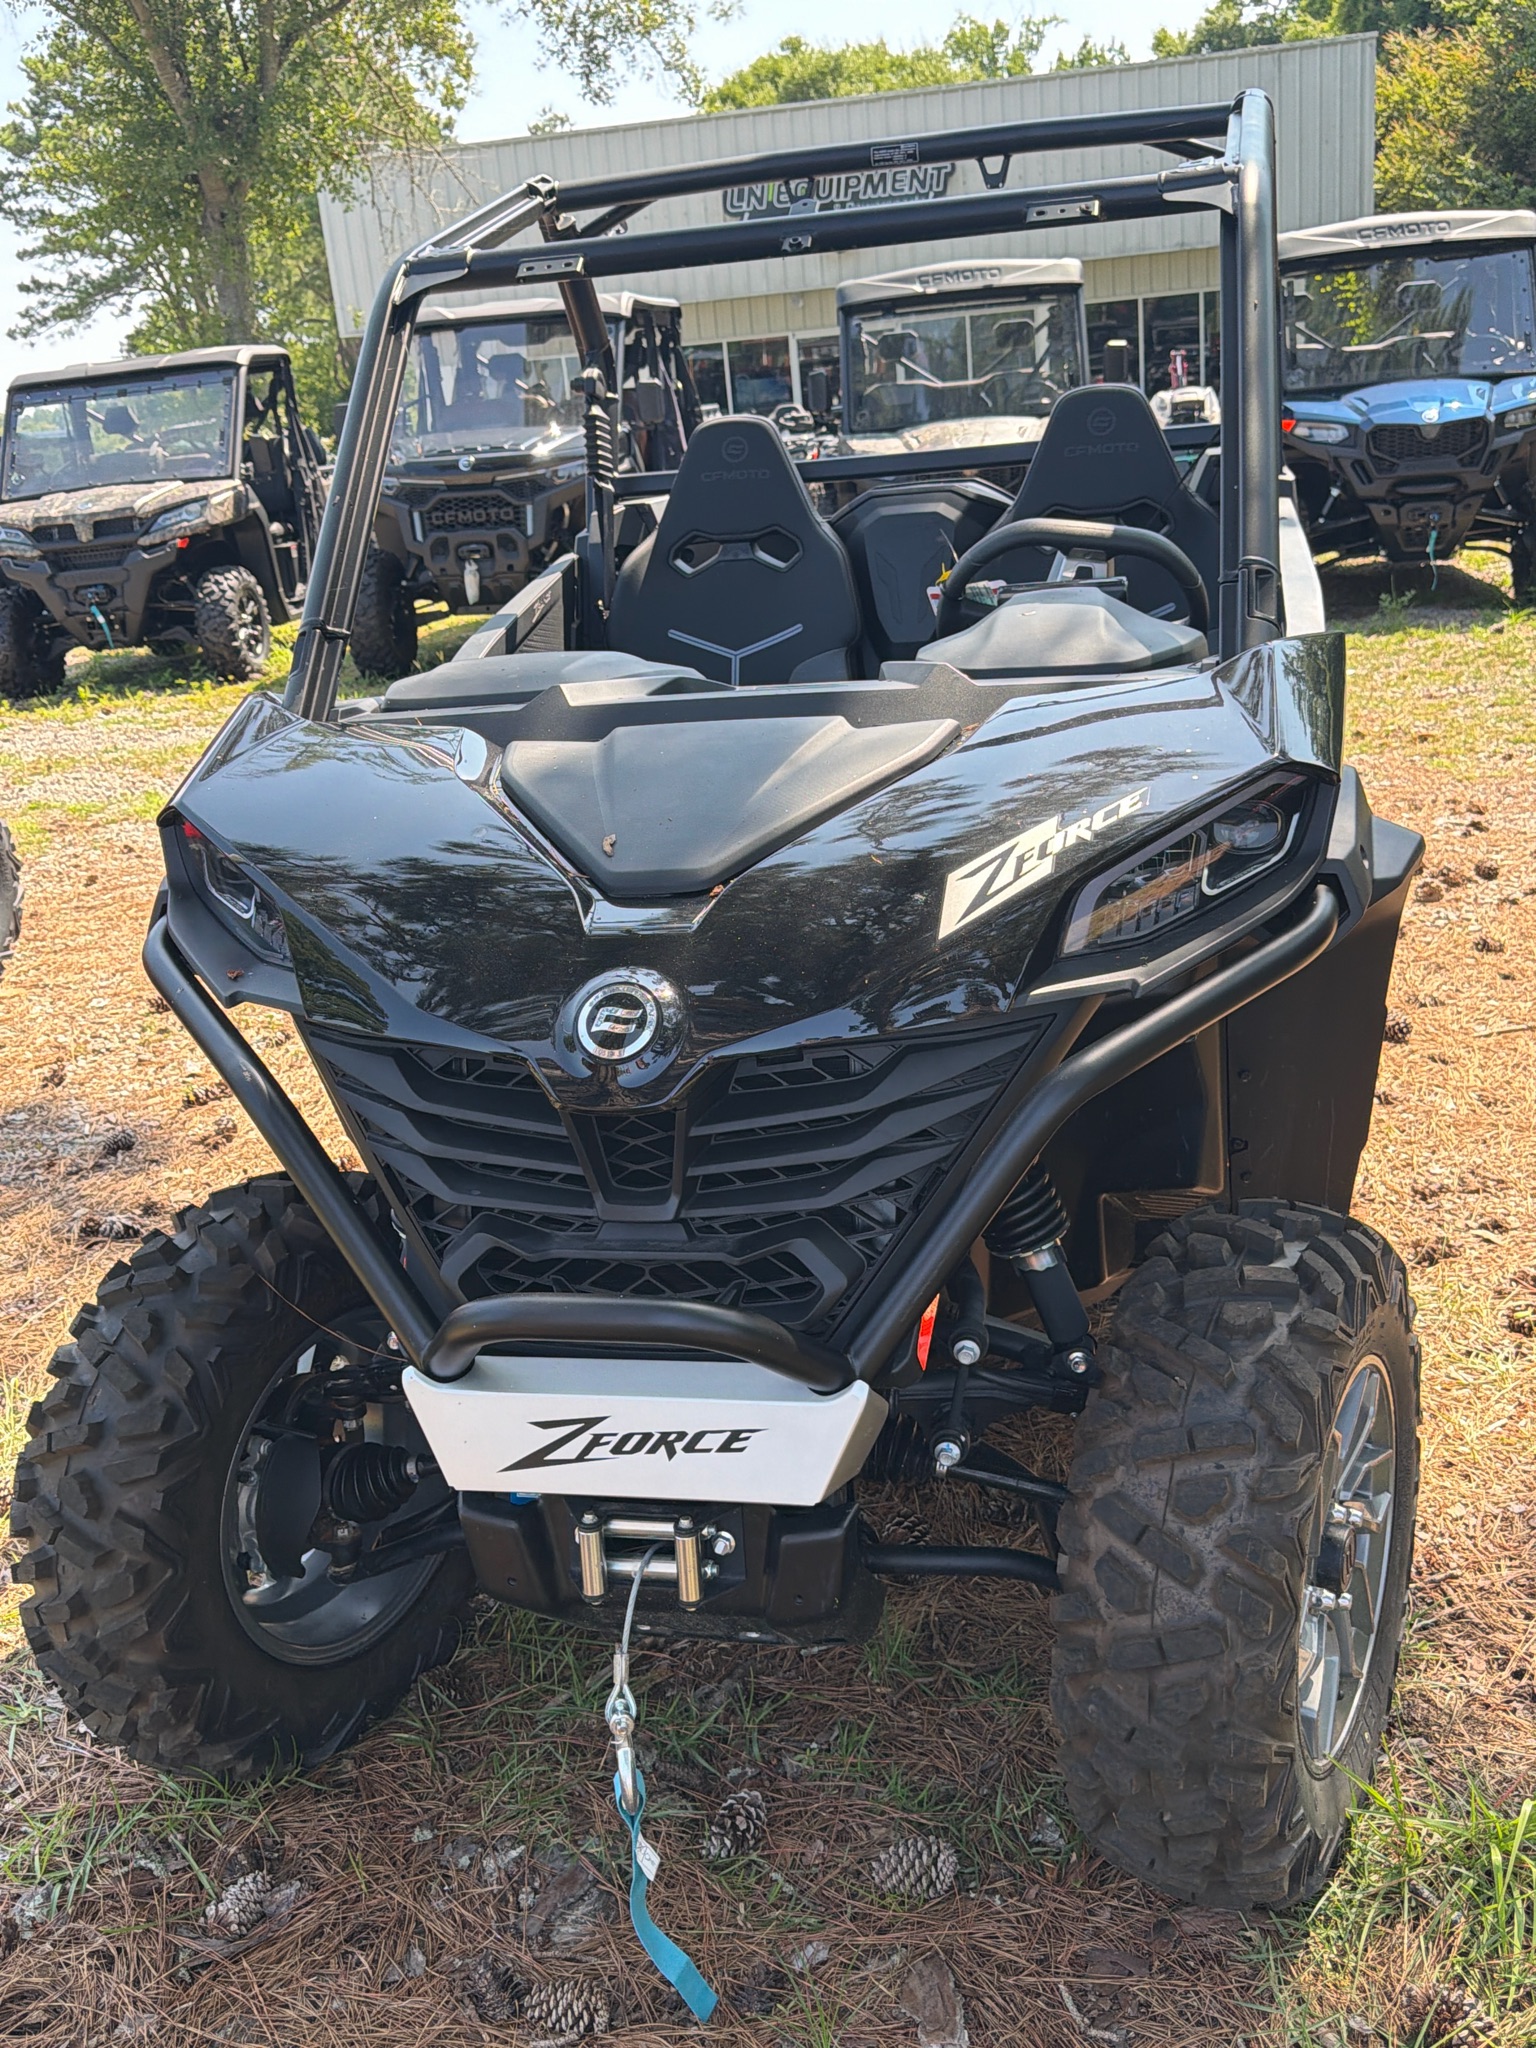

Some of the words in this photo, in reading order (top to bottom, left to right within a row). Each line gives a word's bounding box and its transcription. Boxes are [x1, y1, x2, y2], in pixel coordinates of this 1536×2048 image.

[1356, 220, 1452, 241] CFMOTO
[916, 266, 1002, 287] CFMOTO
[1064, 441, 1140, 457] CFMOTO
[700, 468, 770, 482] CFMOTO
[431, 507, 515, 525] CFMOTO
[496, 1414, 770, 1473] ZFORCE
